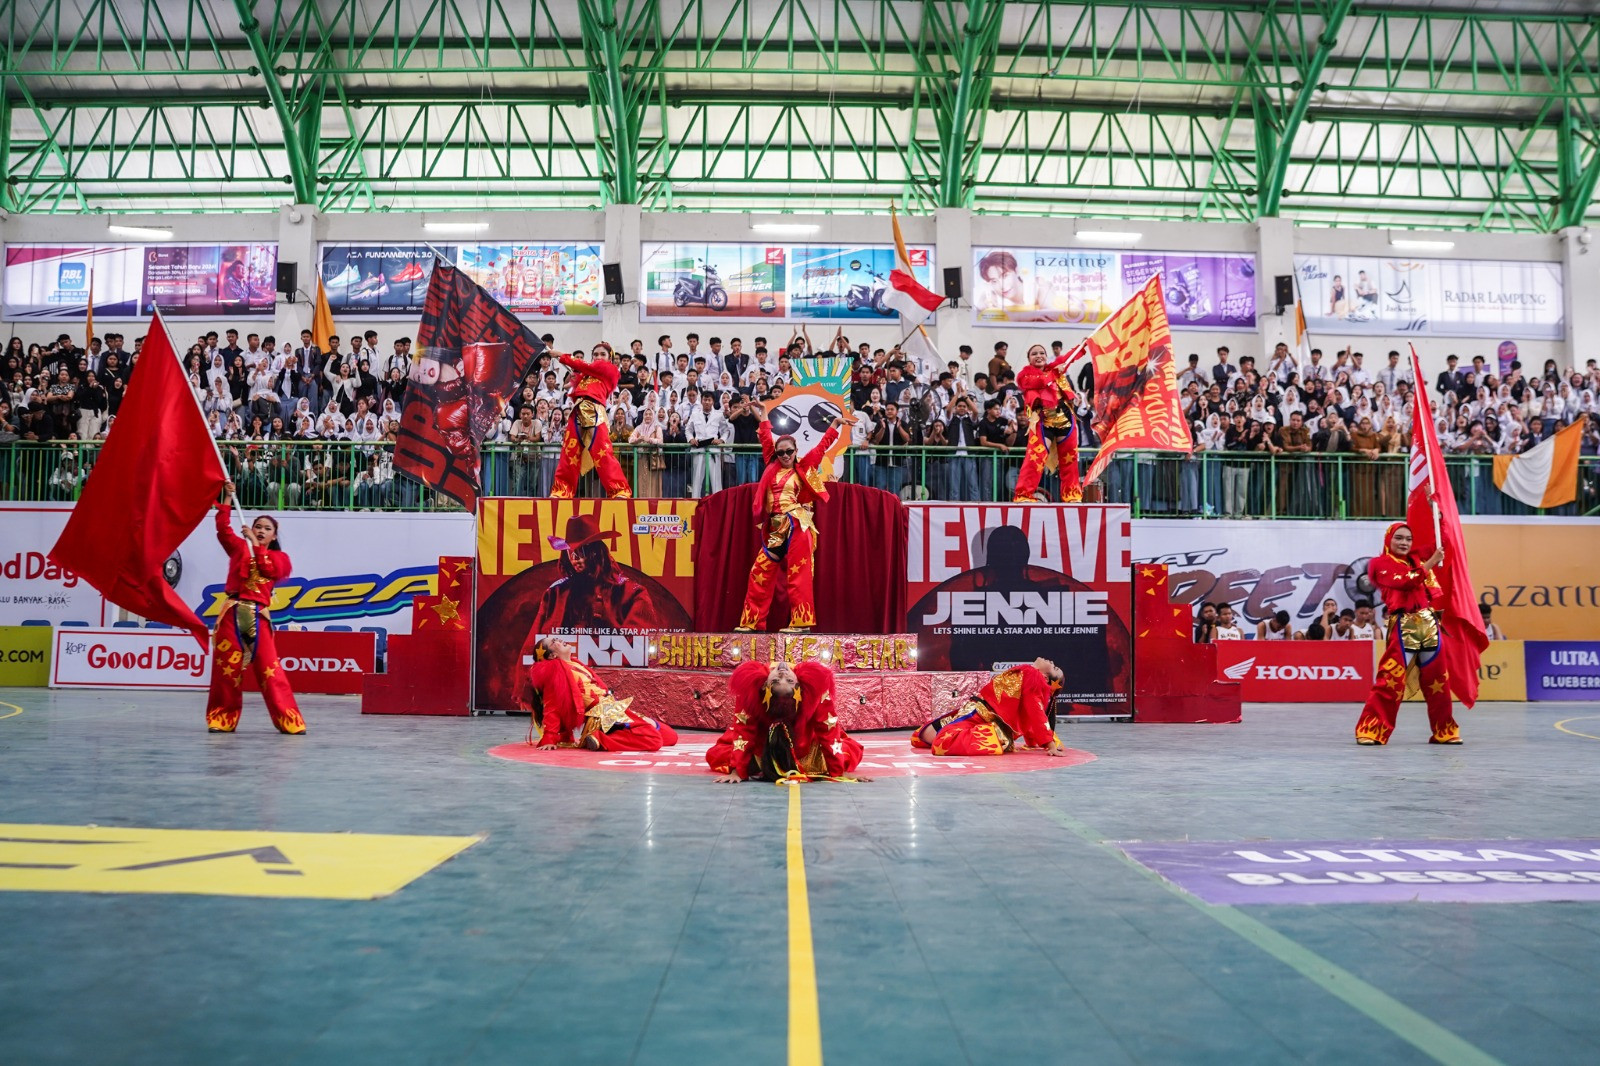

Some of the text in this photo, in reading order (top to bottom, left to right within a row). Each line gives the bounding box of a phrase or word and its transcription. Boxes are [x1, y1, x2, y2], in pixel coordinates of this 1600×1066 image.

[365, 251, 421, 259] FUNDAMENTAL
[1035, 256, 1107, 268] azarine
[62, 269, 83, 280] DBL
[1444, 290, 1547, 306] RADAR LAMPUNG
[14, 596, 43, 604] BANYAK
[922, 591, 1109, 626] JENNIE
[570, 627, 592, 635] SHINE
[593, 627, 611, 635] LIKE
[620, 628, 638, 636] STAR
[933, 627, 951, 635] LETS
[953, 627, 976, 635] SHINE
[977, 627, 994, 635] LIKE
[995, 627, 1003, 635] A
[1004, 627, 1023, 635] STAR
[1024, 627, 1042, 635] AND
[1072, 626, 1099, 634] JENNIE
[65, 641, 87, 655] KOPI
[659, 635, 723, 667] SHINE
[831, 639, 845, 669] A
[856, 639, 908, 669] STAR
[87, 644, 206, 678] Good Day
[277, 657, 363, 673] ONDA
[1550, 650, 1599, 666] ULTRA
[1255, 665, 1362, 680] HONDA
[1233, 848, 1556, 864] ULTRA
